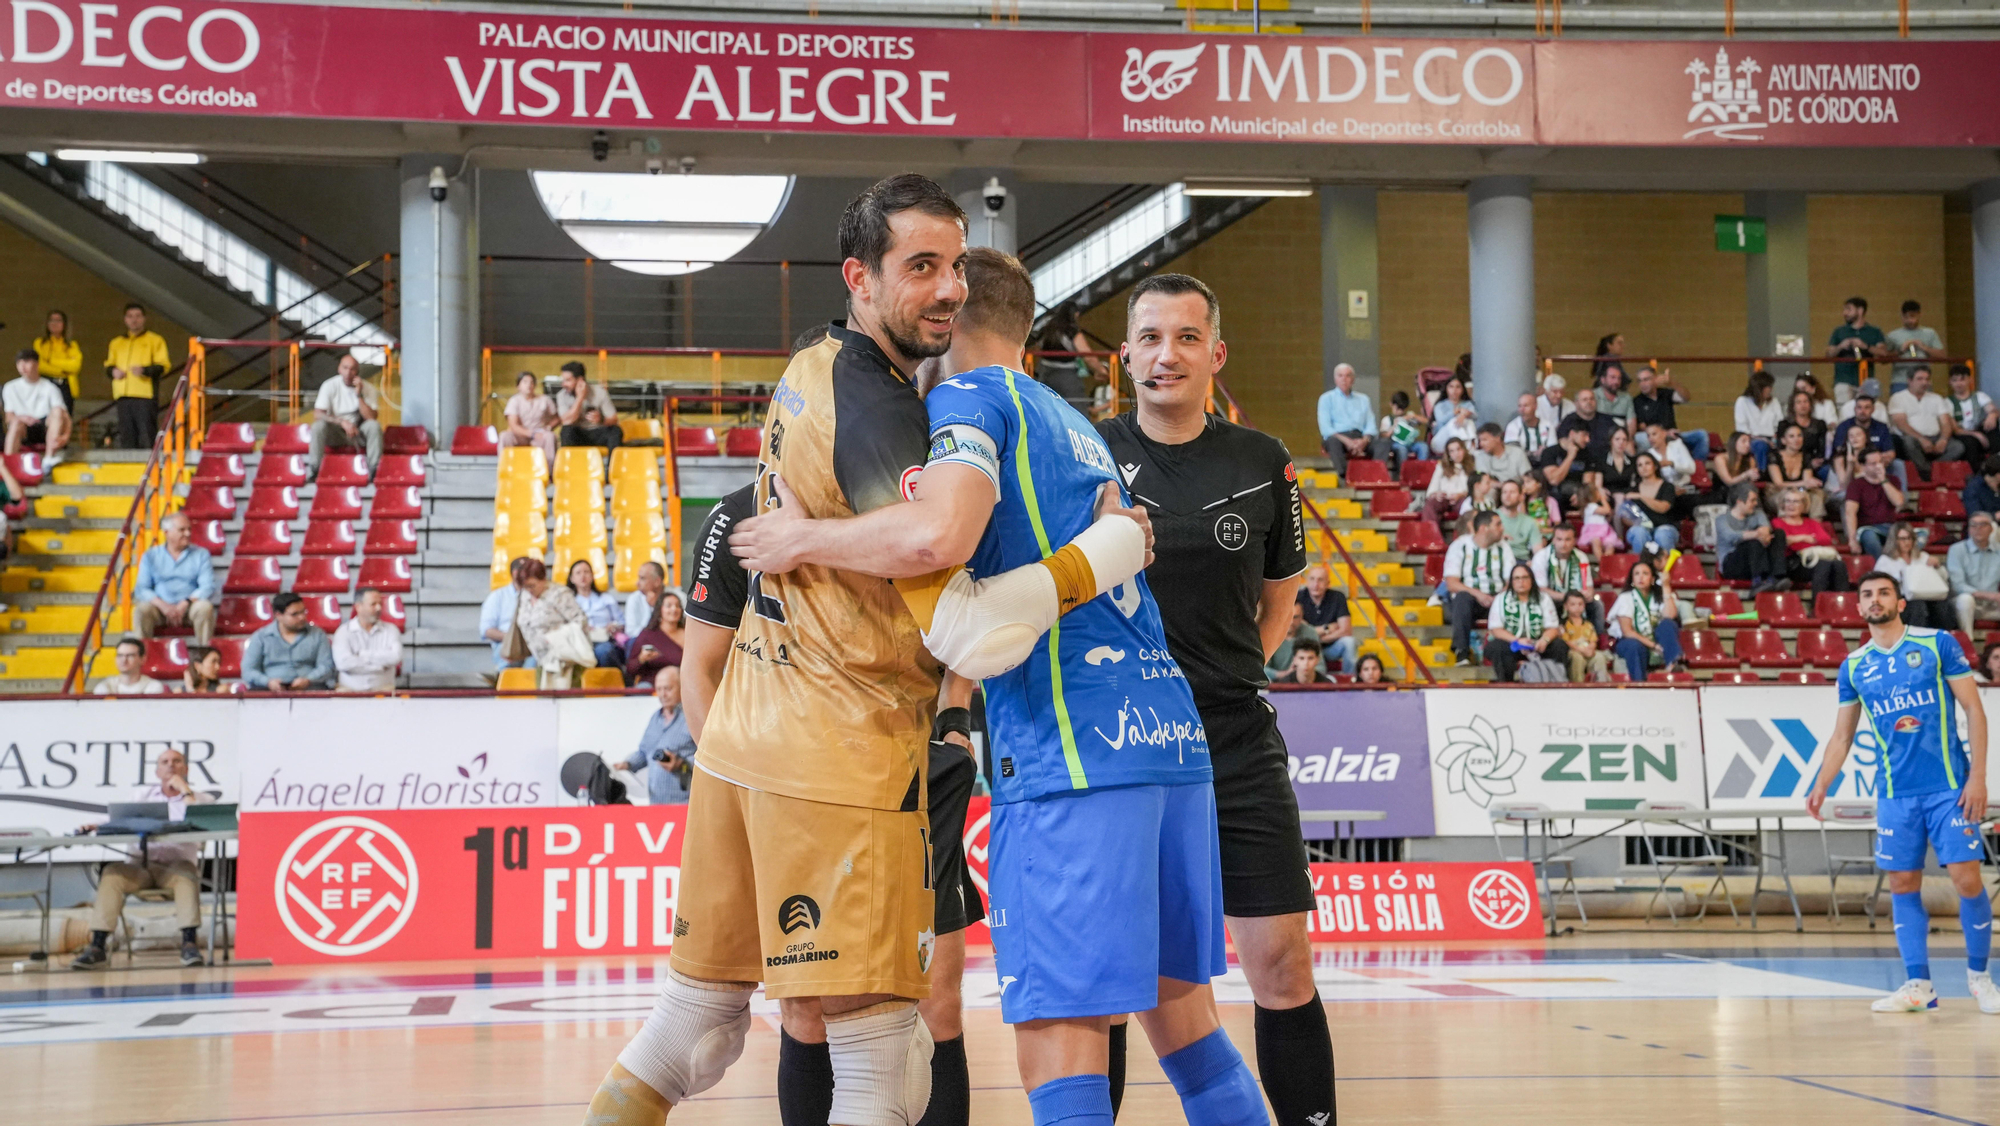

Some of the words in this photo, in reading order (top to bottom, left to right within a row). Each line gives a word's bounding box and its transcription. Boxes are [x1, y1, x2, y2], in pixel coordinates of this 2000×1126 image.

[0, 1, 260, 74] DECO
[478, 22, 606, 51] PALACIO
[612, 28, 769, 56] MUNICIPAL
[777, 33, 915, 60] DEPORTES
[1215, 43, 1524, 107] IMDECO
[1767, 63, 1921, 91] AYUNTAMIENTO
[5, 77, 37, 99] de
[43, 79, 153, 105] Deportes
[157, 83, 259, 108] Córdoba
[444, 56, 654, 119] VISTA
[675, 64, 957, 126] ALEGRE
[1768, 97, 1795, 123] DE
[1798, 92, 1899, 124] CÓRDOBA
[1122, 114, 1205, 134] Instituto
[1209, 115, 1307, 139] Municipal
[1312, 118, 1338, 136] de
[1348, 118, 1434, 139] Deportes
[1438, 119, 1521, 138] Córdoba
[1290, 483, 1303, 552] WÜRTH
[698, 513, 731, 579] WÜRTH
[1141, 666, 1160, 680] LA
[1887, 656, 1897, 674] 2
[1872, 689, 1936, 718] ALBALI
[1541, 723, 1675, 740] Tapizados
[1539, 743, 1678, 782] ZEN
[254, 768, 385, 811] Ángela
[396, 772, 542, 811] floristas
[321, 861, 373, 884] RF
[321, 888, 373, 910] EF
[1374, 893, 1445, 932] SALA
[766, 950, 839, 967] ROSMARINO
[786, 941, 815, 954] GRUPO
